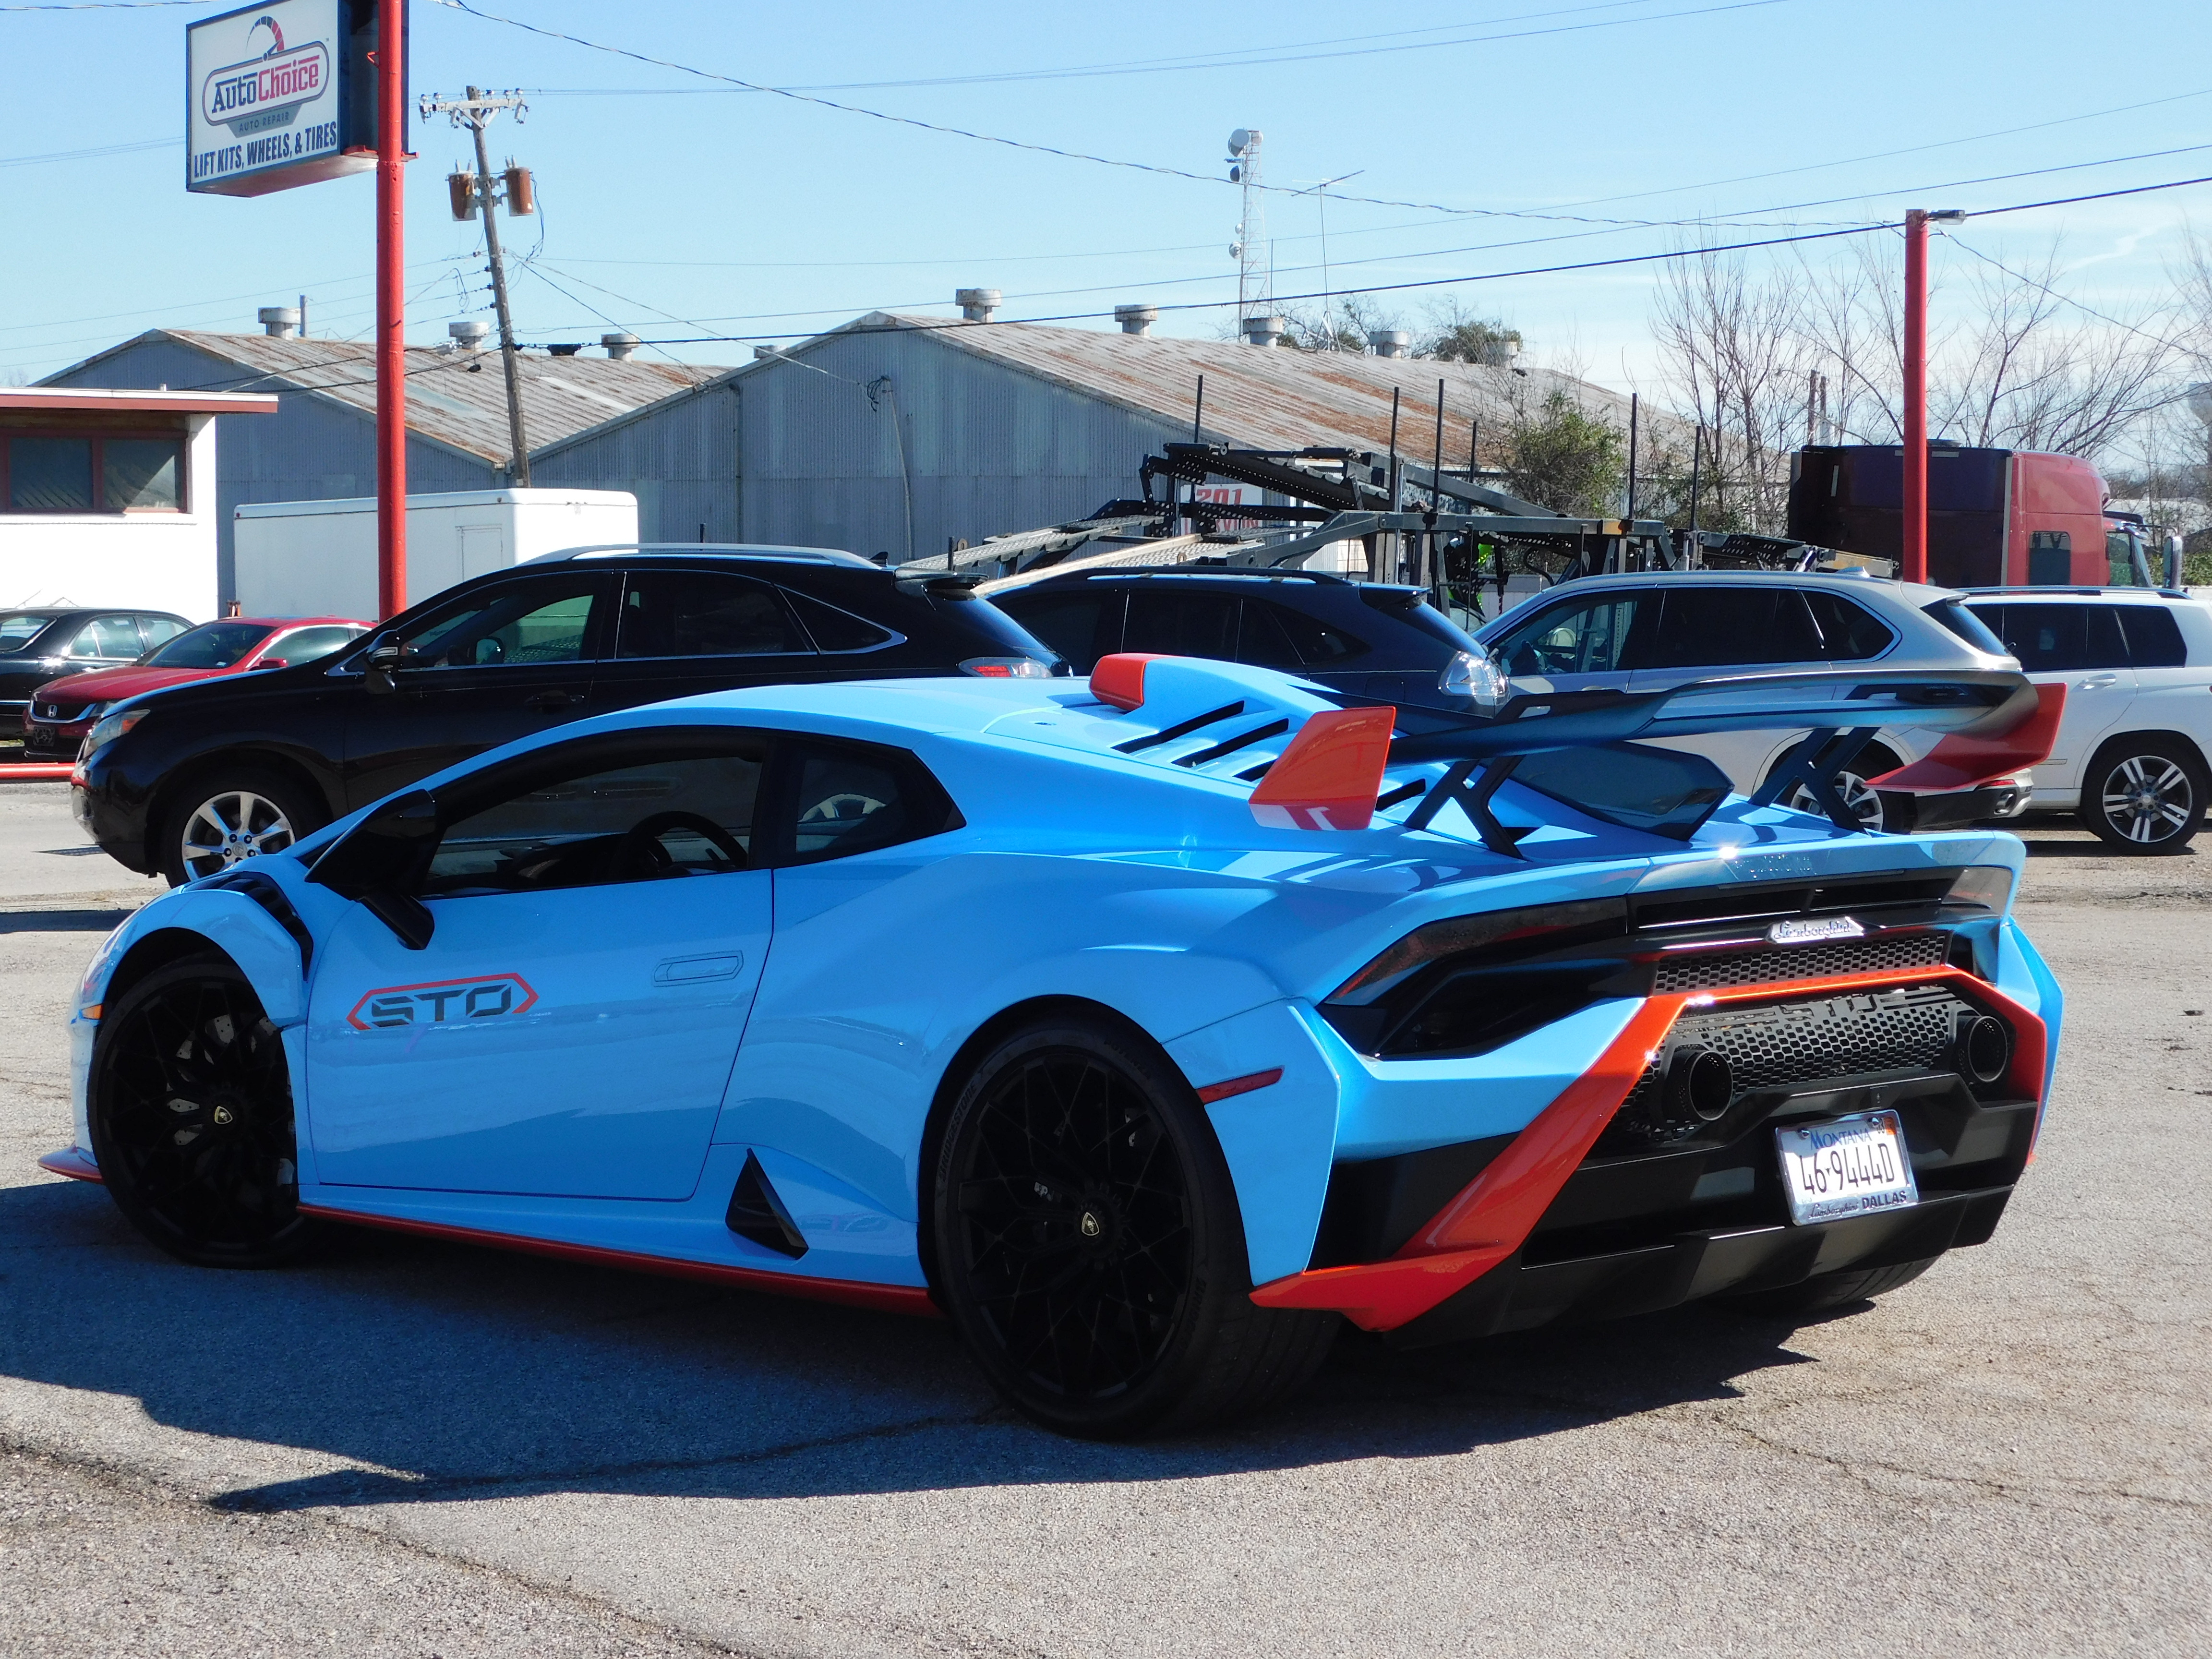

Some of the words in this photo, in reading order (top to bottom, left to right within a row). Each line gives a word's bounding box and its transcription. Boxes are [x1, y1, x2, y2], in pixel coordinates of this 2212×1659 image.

[212, 55, 320, 114] AutoChoice
[239, 121, 260, 132] AUTO
[262, 112, 289, 126] REPAIR
[194, 151, 215, 178] LIFT
[217, 145, 244, 173] KITS,
[247, 133, 293, 165] WHEELS,
[295, 132, 302, 155] &
[305, 121, 337, 153] TIRES
[372, 984, 512, 1028] STO
[1862, 1190, 1907, 1210] DALLAS
